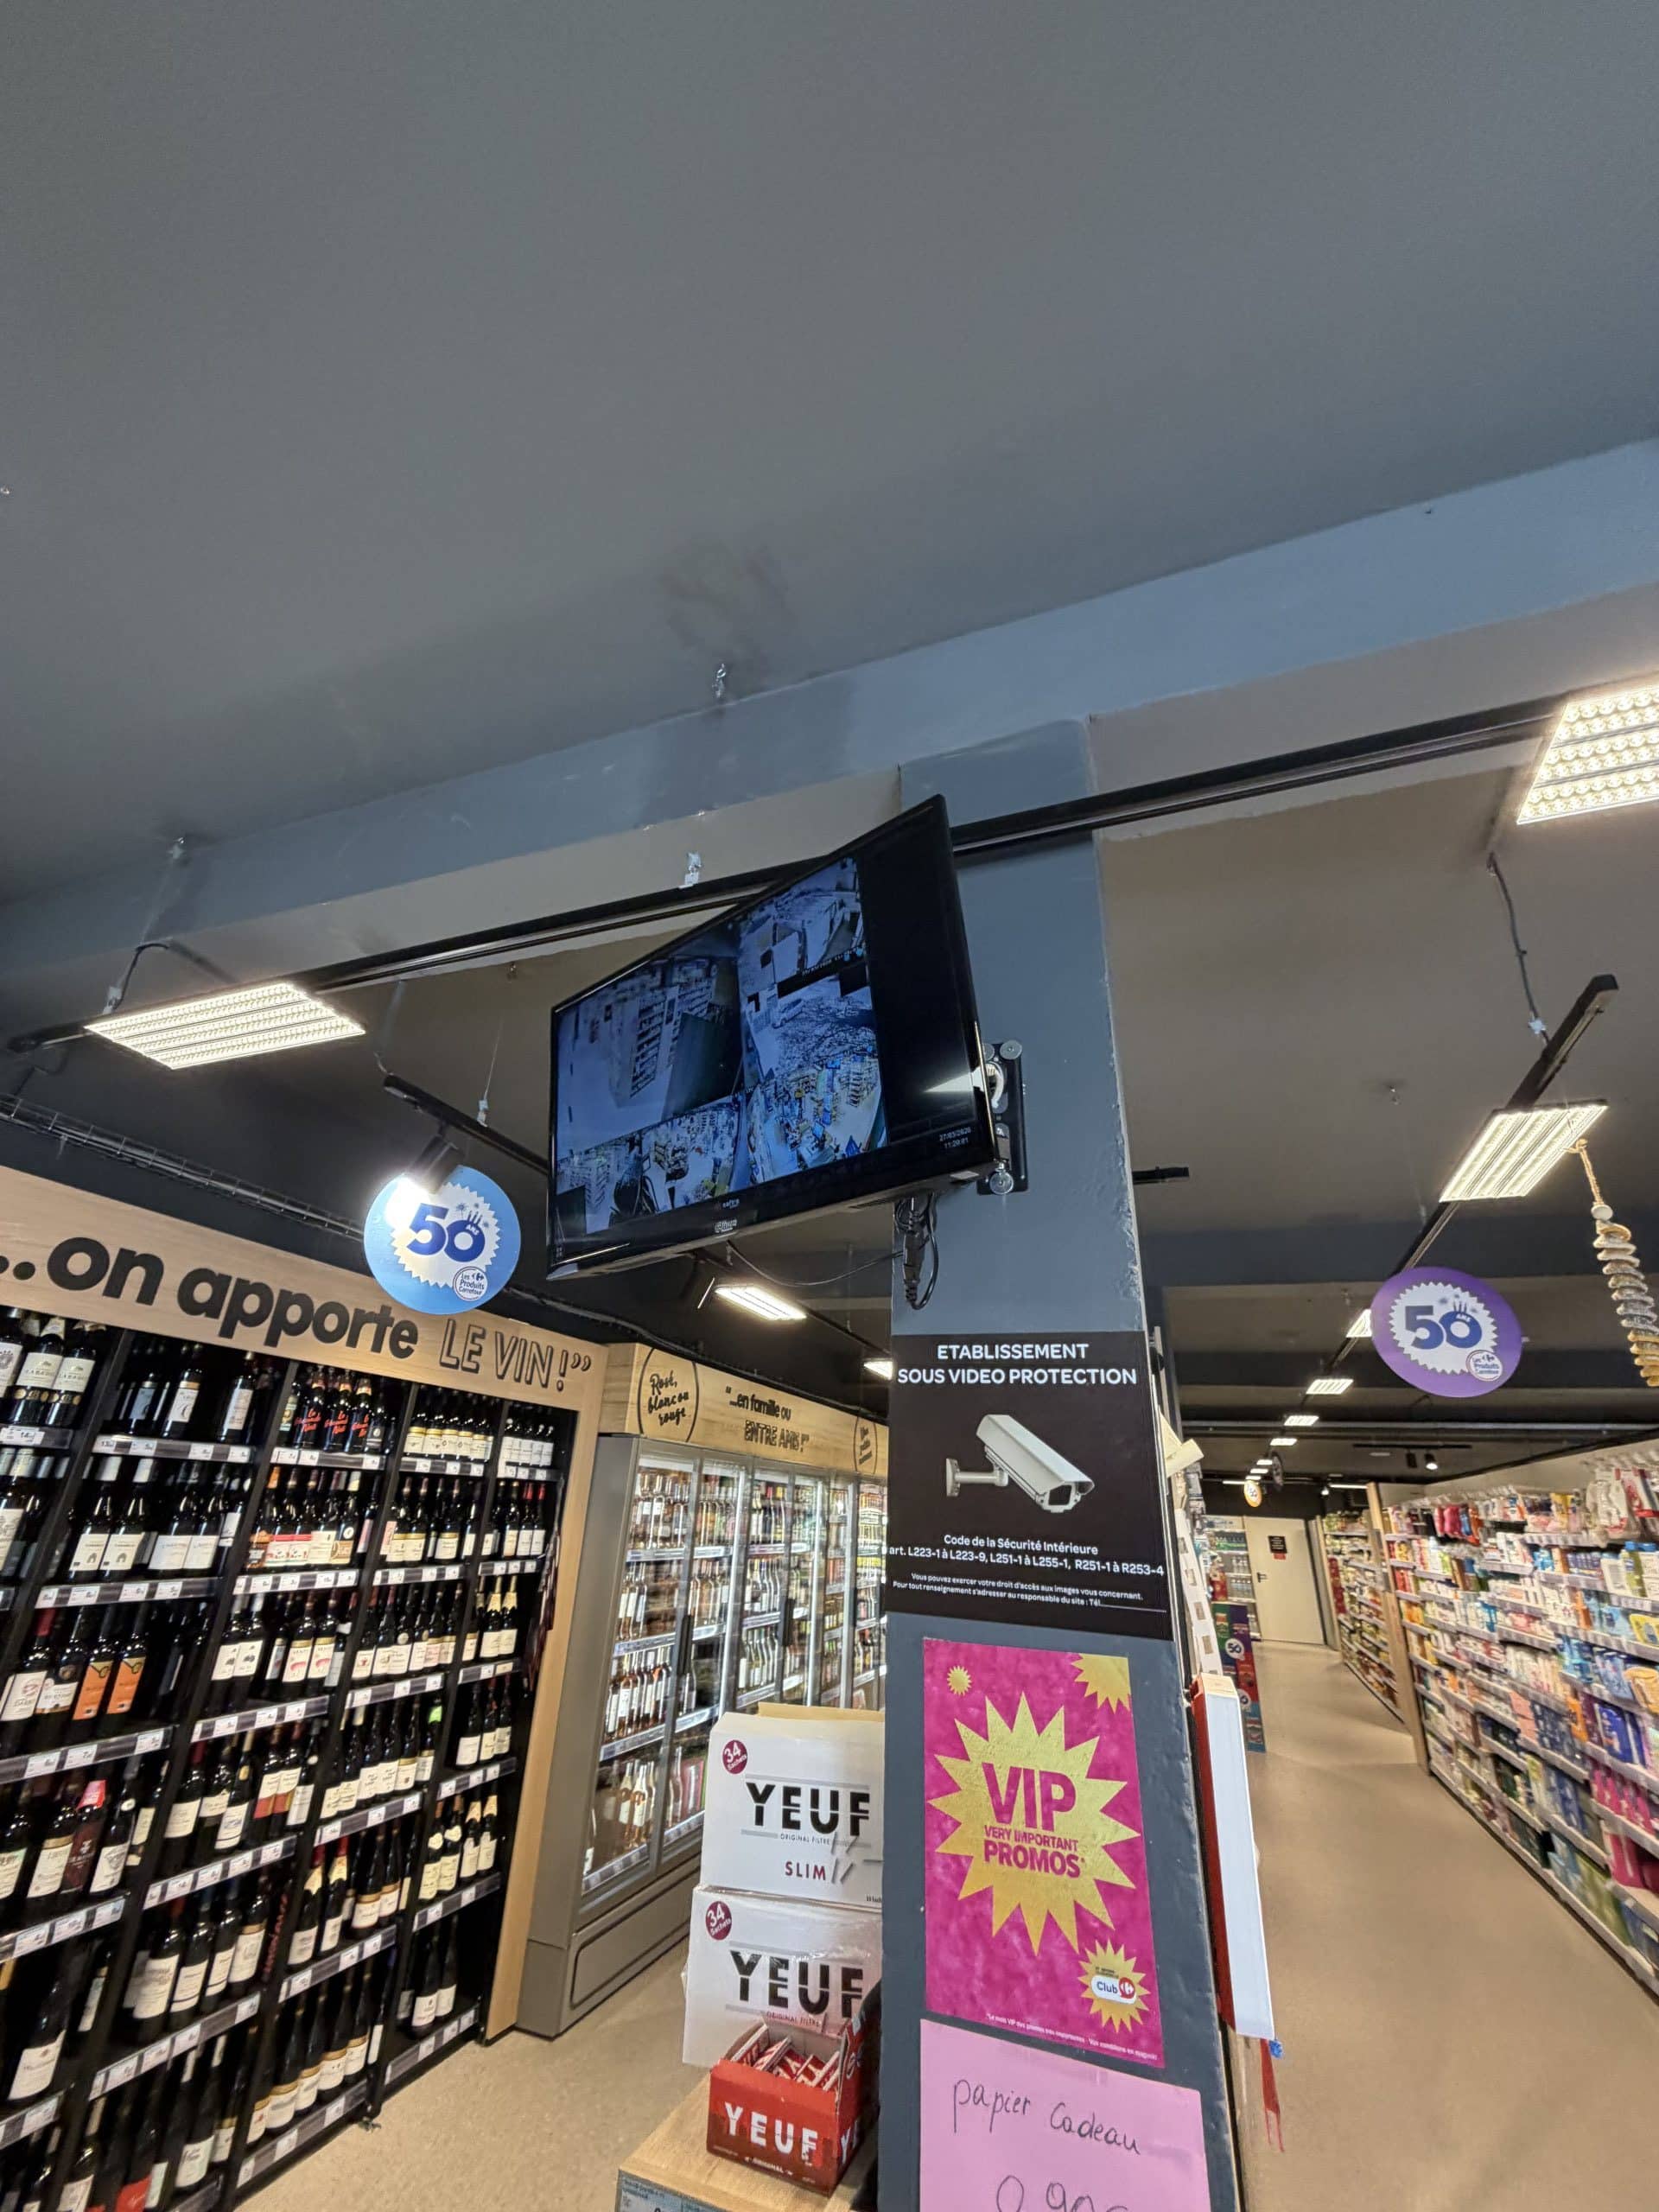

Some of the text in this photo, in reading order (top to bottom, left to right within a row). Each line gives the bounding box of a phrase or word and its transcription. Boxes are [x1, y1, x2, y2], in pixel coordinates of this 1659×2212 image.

[406, 1203, 486, 1262] 50
[460, 1280, 485, 1290] Produits
[177, 1268, 419, 1359] apporte
[439, 1319, 486, 1374] LE
[1405, 1305, 1483, 1350] 50
[937, 1344, 1089, 1360] ETABLISSEMENT
[898, 1368, 1137, 1385] SOUS VIDEO PROTECTION
[648, 1395, 677, 1414] blanc
[658, 1407, 686, 1427] rouge
[750, 1393, 780, 1418] famille
[780, 1406, 791, 1421] ou
[744, 1420, 778, 1446] ENTRE
[944, 1535, 1099, 1555] Code de la Sécurité Intérieure
[888, 1546, 1165, 1577] art. L223-1 à L223-9, L251-1 à L255-1, R251-1 à R253-4
[893, 1580, 908, 1589] Pour
[923, 1584, 972, 1595] renseignement
[972, 1588, 1007, 1599] s'adresser
[1016, 1592, 1060, 1605] responsable
[1060, 1596, 1071, 1605] du
[1071, 1597, 1084, 1606] site
[911, 1573, 927, 1581] Vous
[927, 1574, 950, 1584] pouvez
[951, 1577, 977, 1586] exercer
[977, 1579, 995, 1587] votre
[996, 1580, 1014, 1589] droit
[1014, 1581, 1039, 1592] d'accès
[1040, 1584, 1053, 1592] aux
[1054, 1585, 1080, 1596] images
[1080, 1588, 1097, 1597] vous
[723, 1741, 741, 1764] 34
[746, 1782, 870, 1837] YEUF
[982, 1762, 1076, 1832] VIP
[780, 1833, 830, 1846] ORIGINAL FILTRE
[983, 1824, 1079, 1852] VERY IMPORTANT
[785, 1860, 827, 1882] SLIM
[707, 1903, 726, 1928] 34
[710, 1918, 733, 1936] Sachets
[729, 1949, 864, 2018] YEUF
[1096, 1980, 1118, 1994] Club
[766, 2011, 798, 2024] ORIGINAL
[953, 2079, 1032, 2133] papier
[724, 2101, 819, 2161] YEUF
